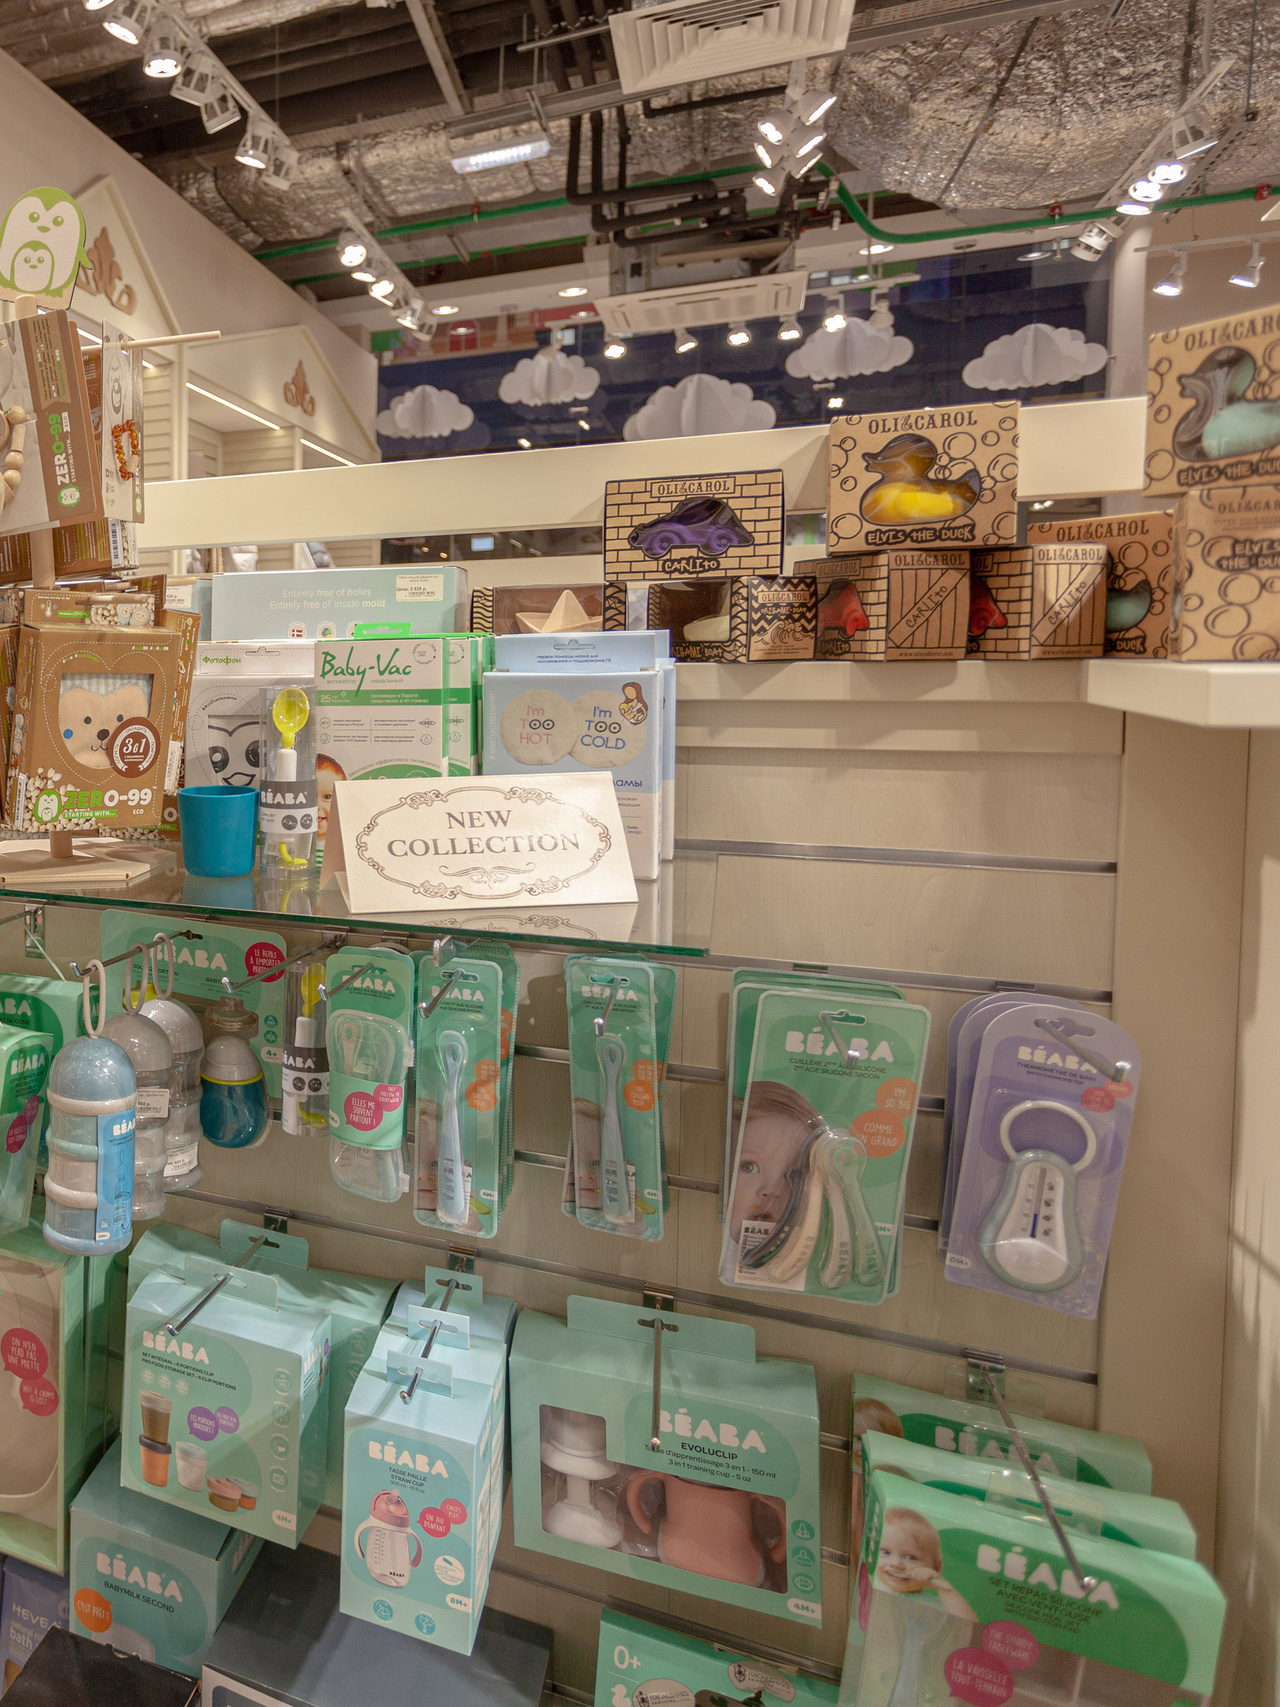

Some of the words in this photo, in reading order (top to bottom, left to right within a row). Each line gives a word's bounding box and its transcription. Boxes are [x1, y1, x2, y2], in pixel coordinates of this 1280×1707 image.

[1184, 312, 1280, 352] OLI&CAR
[869, 411, 978, 434] OLI&CAROL
[48, 413, 70, 486] ZERO-99
[658, 480, 730, 495] OLI&CAROL
[1218, 500, 1280, 514] OLI&CAR
[868, 530, 905, 545] ELVIS
[941, 527, 973, 540] DUCK
[1056, 520, 1149, 542] OLI&CAROL
[894, 554, 965, 567] OLI&CAROL
[1038, 549, 1103, 561] OLI&CAROL
[282, 589, 315, 599] Entirely
[317, 588, 334, 598] free
[336, 587, 346, 597] of
[348, 587, 372, 597] holes
[270, 601, 301, 611] Entirely
[303, 599, 320, 609] free
[322, 599, 332, 609] of
[334, 599, 360, 609] inside
[362, 598, 386, 608] mold
[202, 655, 242, 666] Фотофон
[320, 646, 412, 698] Baby-Vac
[320, 694, 331, 703] 25
[526, 705, 545, 717] I'm
[593, 706, 612, 718] I'm
[519, 733, 553, 745] HOT
[581, 734, 626, 750] COLD
[64, 788, 153, 809] ZERO-99
[445, 810, 512, 829] NEW
[387, 833, 580, 857] COLLECTION
[254, 949, 261, 957] LE
[262, 949, 277, 959] REPAS
[785, 1026, 894, 1063] BÉABA
[10, 1052, 45, 1075] BÉABA
[1018, 1045, 1098, 1074] BÉABA
[821, 1068, 854, 1077] SILICONE
[855, 1072, 880, 1080] SPOON
[351, 1097, 367, 1108] ELLES
[368, 1101, 376, 1110] ME
[352, 1107, 374, 1117] SUIVENT
[885, 1099, 895, 1108] SO
[898, 1100, 911, 1110] BIG
[349, 1114, 372, 1125] PARTOUT
[864, 1122, 893, 1135] COMME
[870, 1135, 898, 1147] GRAND
[11, 1336, 20, 1347] ON
[142, 1330, 209, 1365] BÉABA
[7, 1354, 19, 1366] UNE
[20, 1358, 40, 1373] MIETTE
[26, 1350, 37, 1361] PAS
[659, 1407, 767, 1454] BÉABA
[369, 1440, 449, 1479] BÉABA
[681, 1441, 738, 1461] EVOLUCLIP
[644, 1444, 665, 1456] Tae
[665, 1448, 724, 1468] d'apprentissage
[751, 1467, 765, 1476] 150
[766, 1470, 777, 1479] ml
[668, 1458, 674, 1466] 3
[674, 1459, 682, 1467] in
[687, 1463, 715, 1476] training
[716, 1469, 731, 1479] cup
[388, 1467, 407, 1477] TASSE
[407, 1471, 428, 1483] PAILLE
[390, 1473, 412, 1485] STRAW
[412, 1479, 425, 1488] CUP
[425, 1513, 433, 1521] UN
[435, 1515, 445, 1524] JEU
[96, 1552, 183, 1603] BÉABA
[977, 1544, 1119, 1610] BÉABA
[104, 1581, 141, 1601] BABYMILK
[142, 1595, 175, 1613] SECOND
[988, 1577, 1010, 1589] SET
[1011, 1583, 1048, 1601] REPAS
[1049, 1593, 1103, 1618] SILICONE
[793, 1601, 816, 1614] 4M+
[996, 1590, 1026, 1605] AVEC
[1026, 1599, 1091, 1624] VENTOUSE
[9, 1627, 33, 1650] bath
[613, 1645, 642, 1670] 0+
[952, 1659, 964, 1671] LA
[967, 1662, 1008, 1685] VAISSELLE
